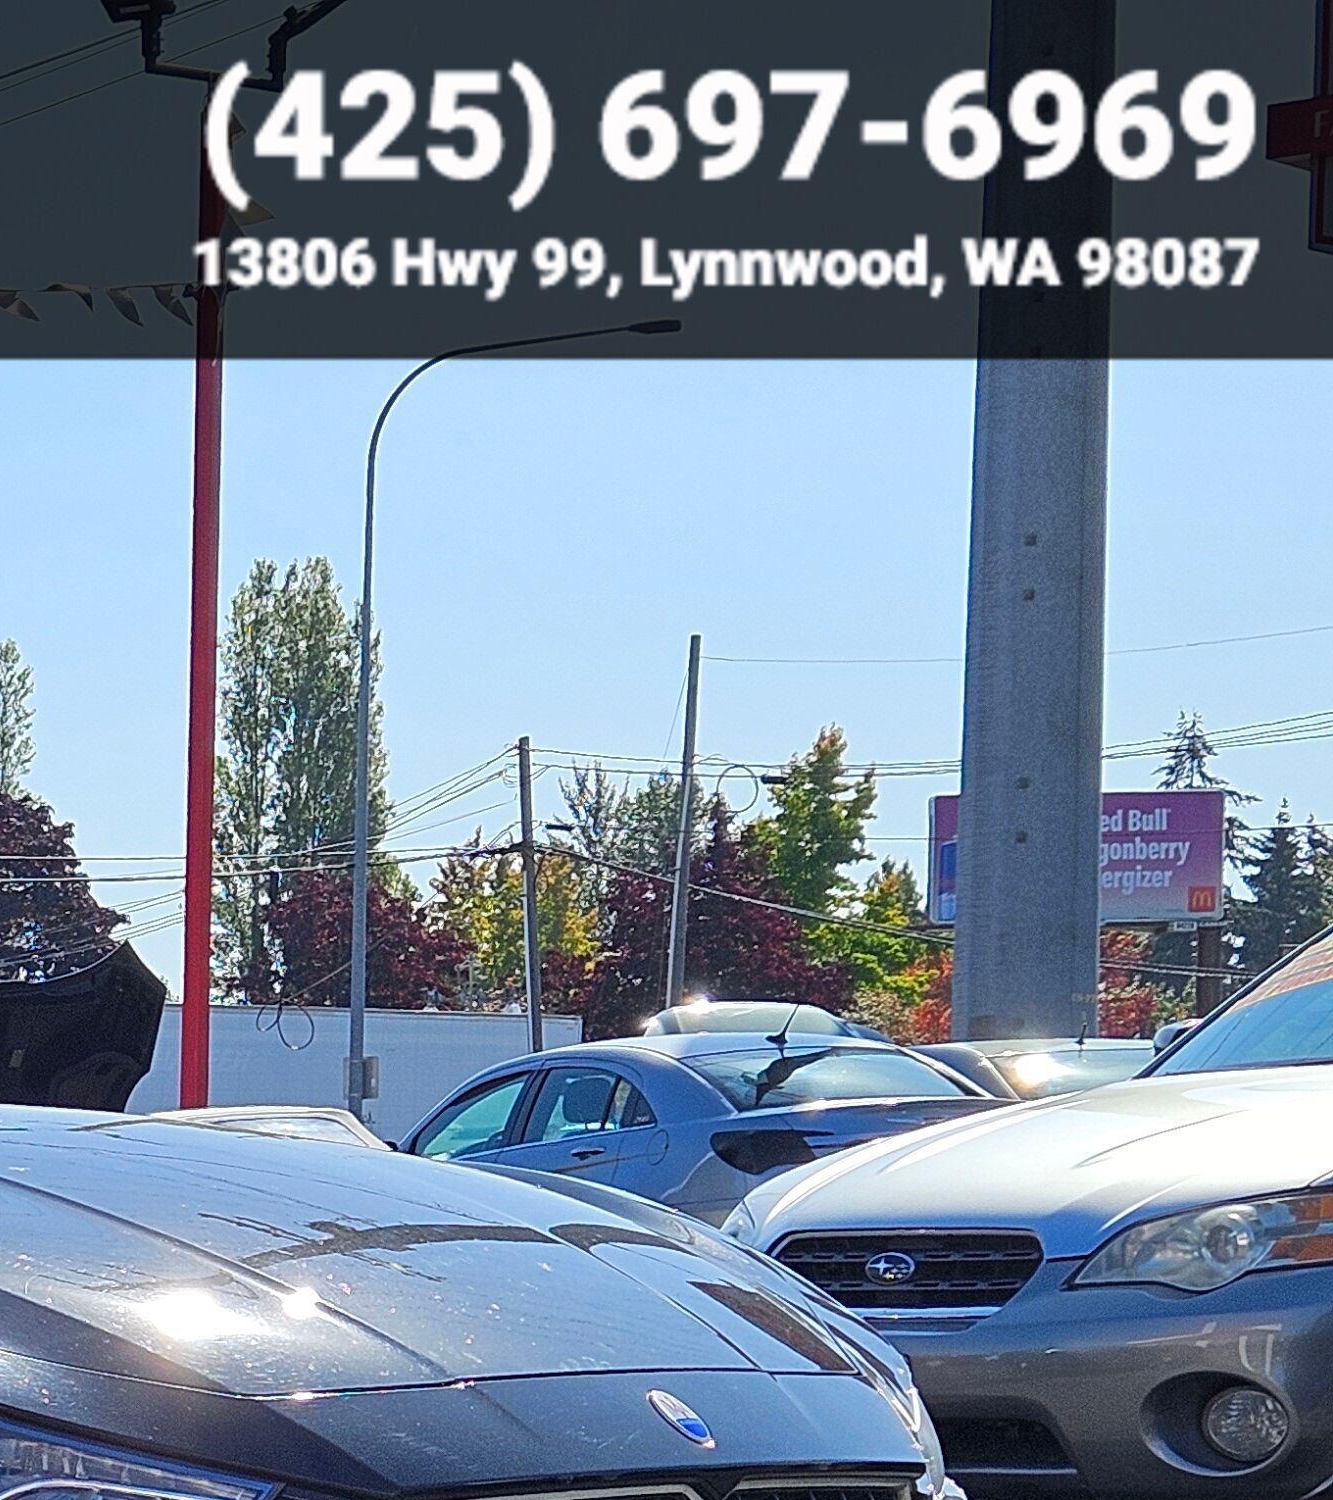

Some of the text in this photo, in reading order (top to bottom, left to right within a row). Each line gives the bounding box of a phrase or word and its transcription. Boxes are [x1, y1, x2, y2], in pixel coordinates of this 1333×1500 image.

[1100, 808, 1168, 832] ed Bull
[1100, 837, 1190, 866] gonberry
[1102, 865, 1173, 895] ergizer
